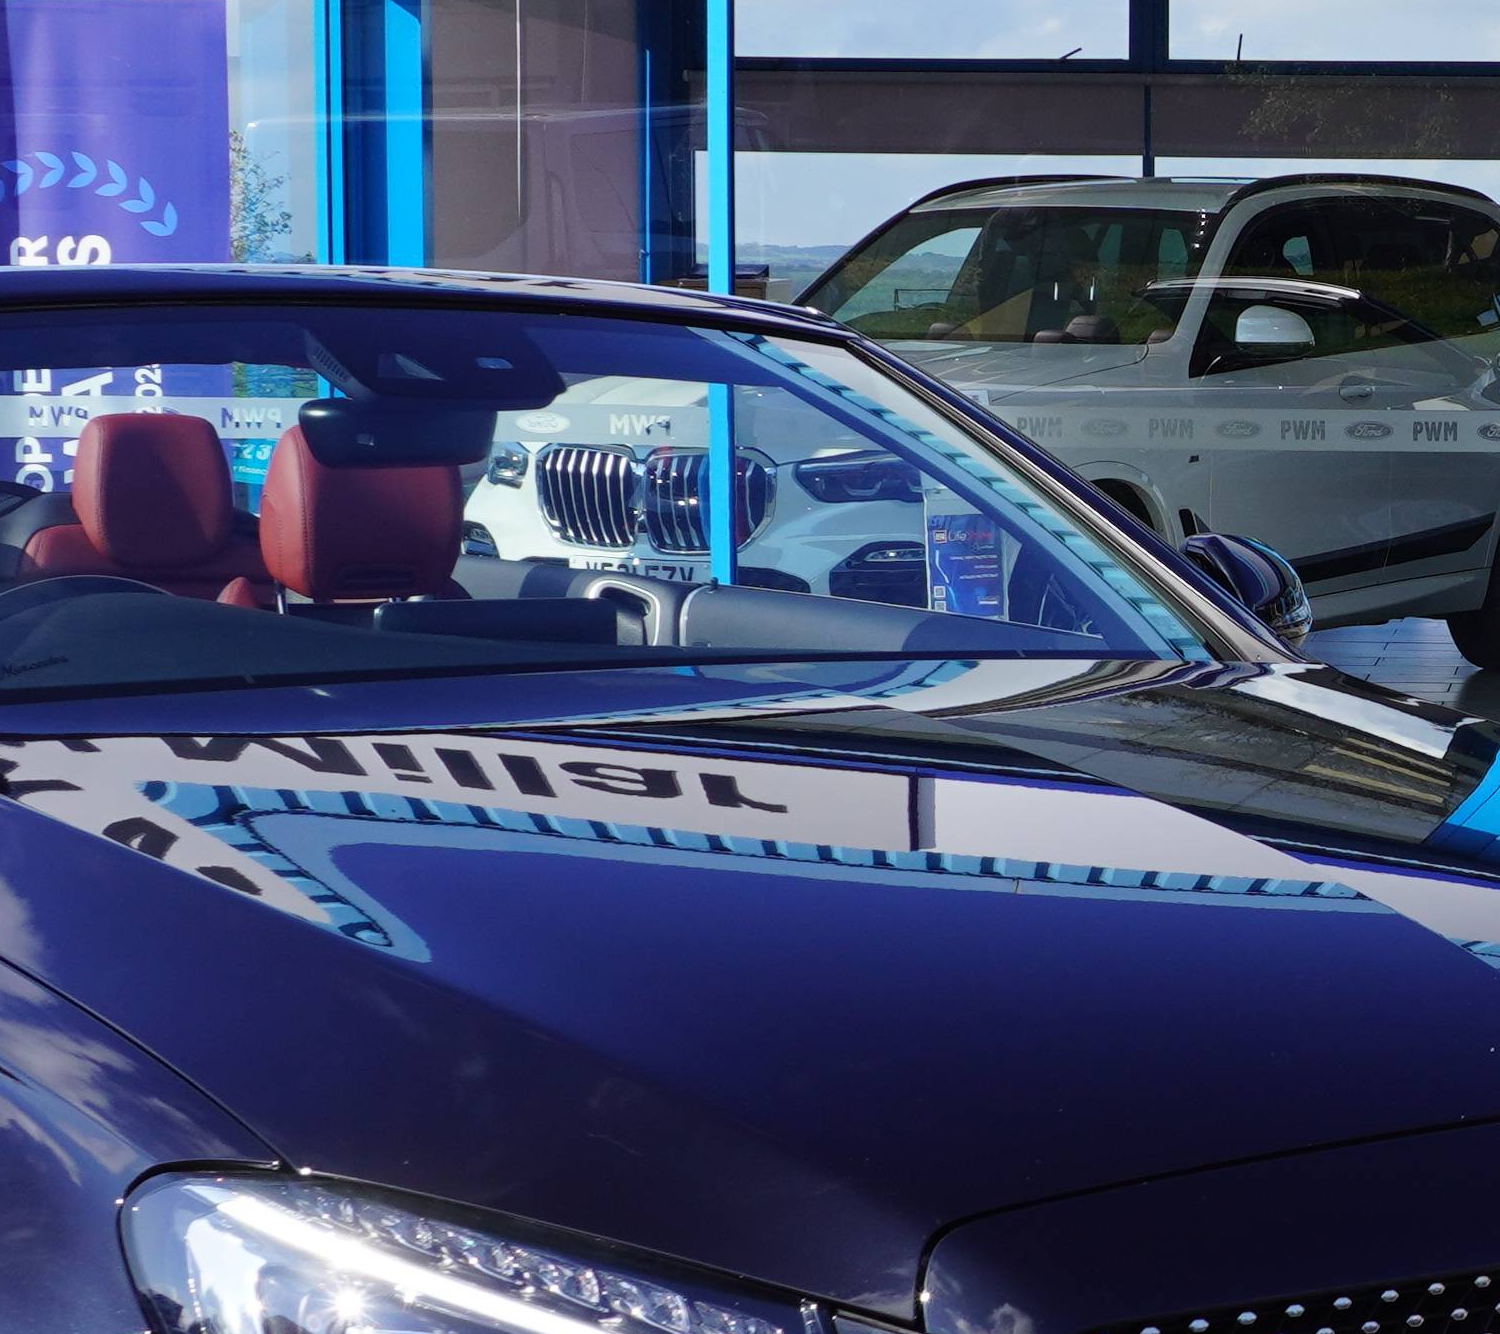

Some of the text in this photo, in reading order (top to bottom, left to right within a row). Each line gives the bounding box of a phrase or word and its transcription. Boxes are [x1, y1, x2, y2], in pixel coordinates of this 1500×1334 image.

[1149, 418, 1194, 439] PWM
[1280, 420, 1326, 441] PWM
[1350, 423, 1389, 440] Ford
[1412, 420, 1458, 442] PWM
